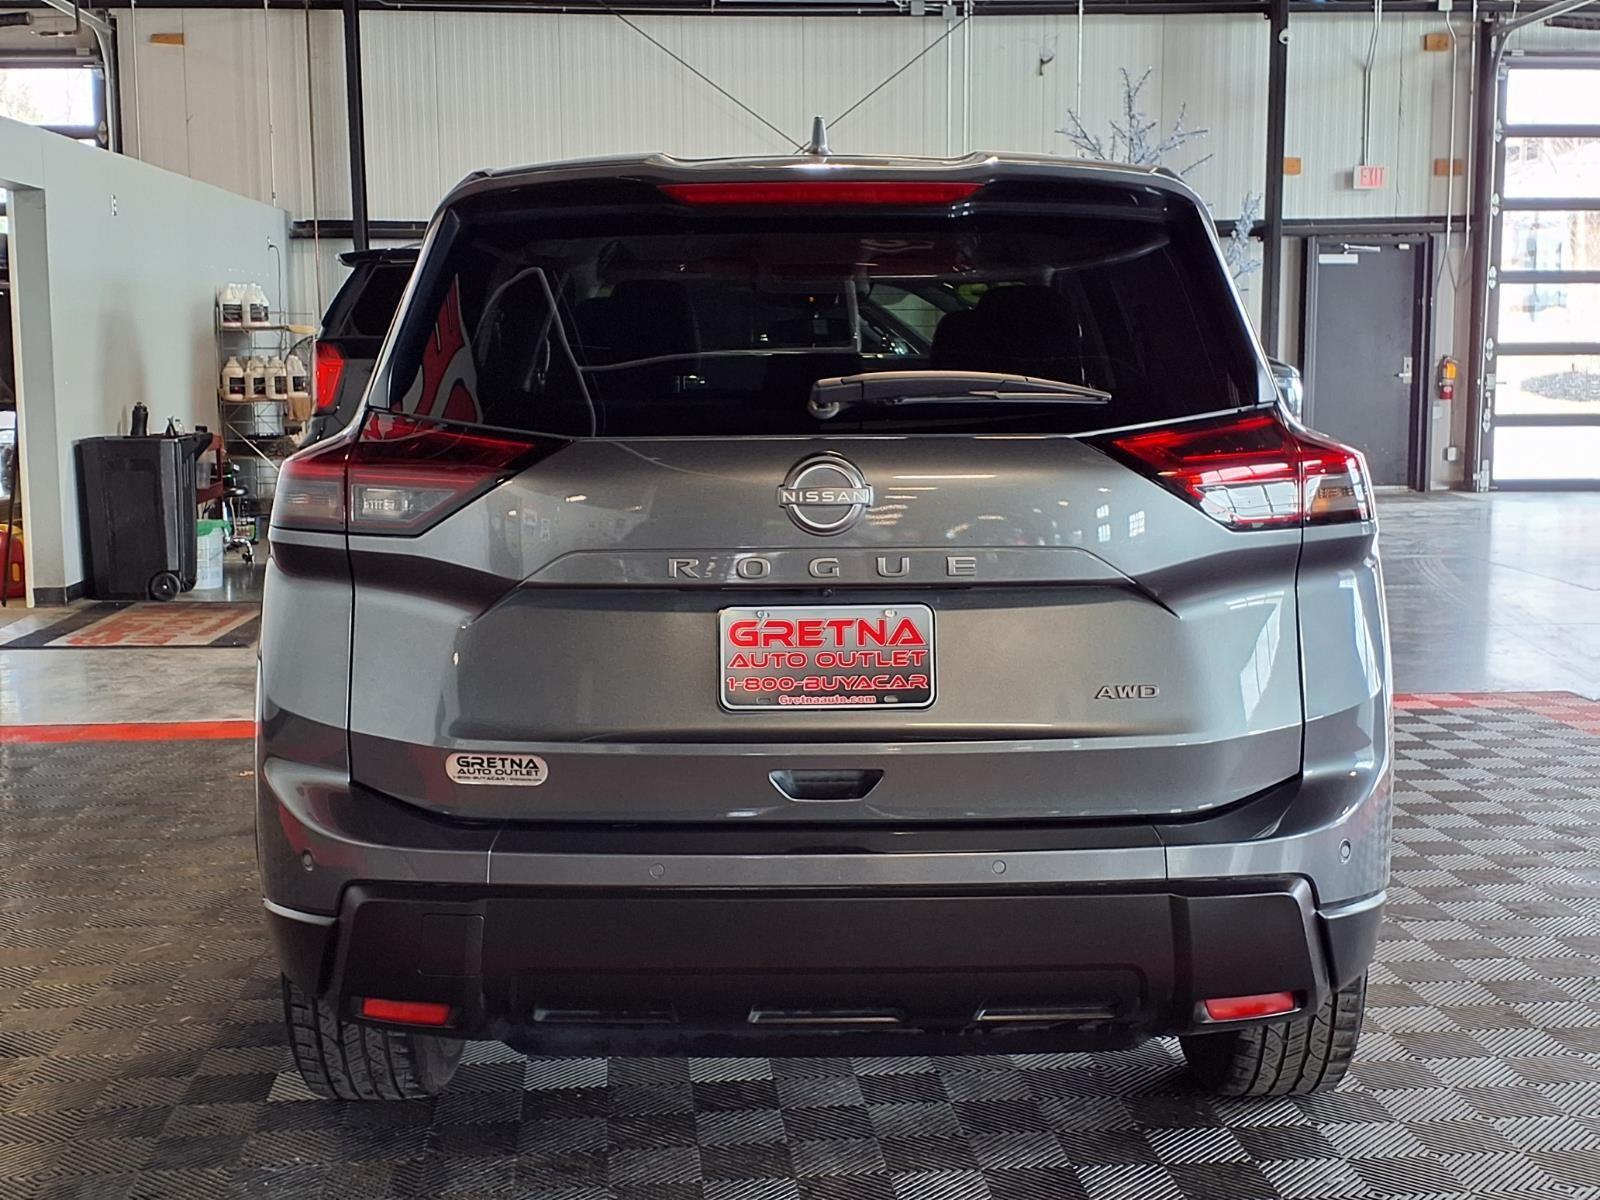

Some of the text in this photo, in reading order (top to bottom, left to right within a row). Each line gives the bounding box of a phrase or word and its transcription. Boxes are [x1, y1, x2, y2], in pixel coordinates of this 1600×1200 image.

[1360, 167, 1385, 185] EXIT
[781, 490, 868, 503] NISSAN
[667, 556, 977, 579] ROGUE
[727, 617, 928, 648] GRETNA
[727, 650, 928, 669] AUTO OUTLET
[727, 675, 928, 692] 1-800-BUYACAR
[778, 694, 877, 705] Gretnaauto.com
[1094, 685, 1160, 699] AWD
[456, 756, 540, 769] GRETNA
[457, 768, 540, 776] AUTO OUTLET
